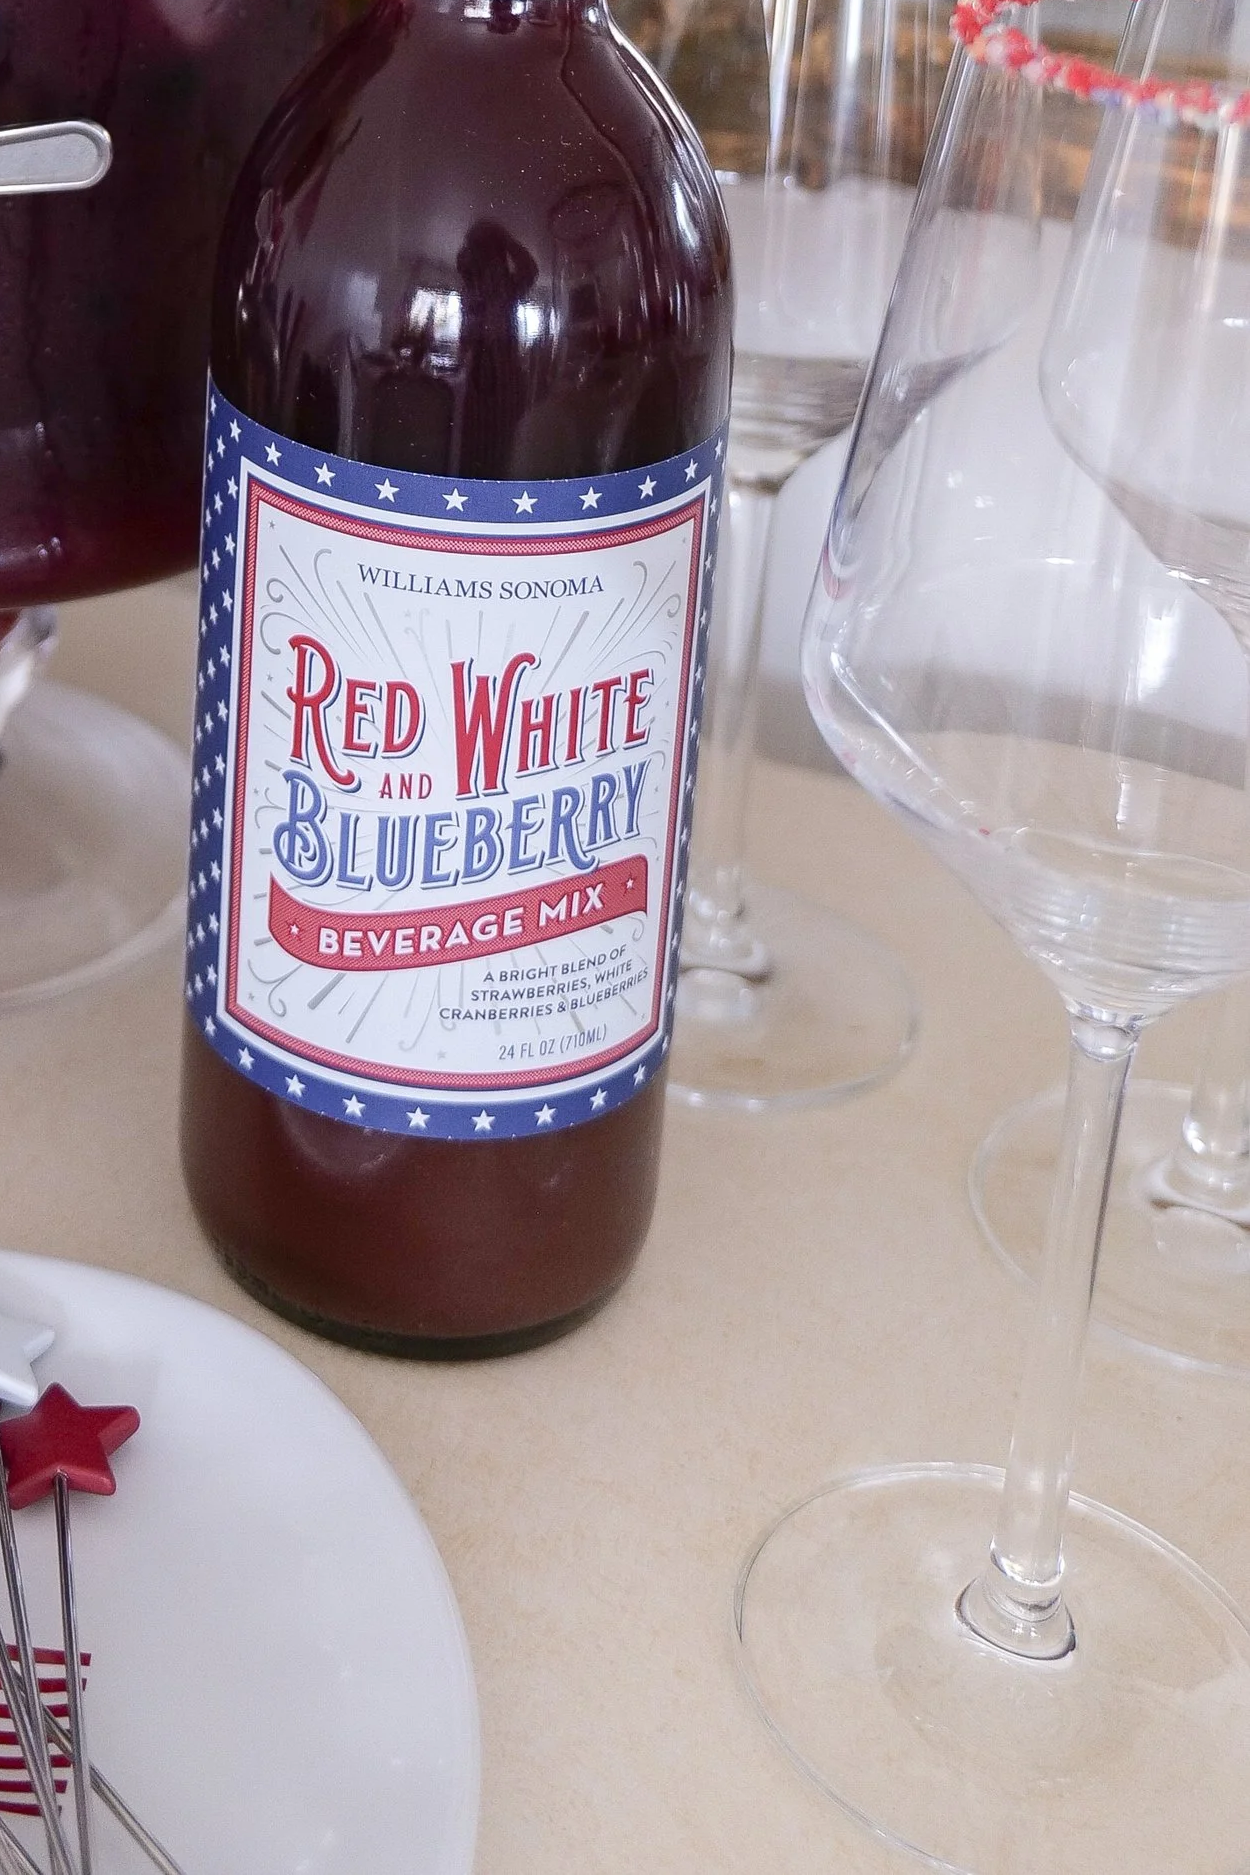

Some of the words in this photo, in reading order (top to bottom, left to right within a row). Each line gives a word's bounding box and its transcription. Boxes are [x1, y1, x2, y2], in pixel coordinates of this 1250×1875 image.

[357, 563, 493, 600] WILLIAMS
[499, 574, 605, 601] SONOMA
[286, 633, 427, 792] RED
[450, 652, 654, 800] WHITE
[380, 773, 432, 800] AND
[273, 759, 651, 892] BLUEBERRY
[318, 907, 525, 957] BEVERAGE
[538, 882, 605, 927] MIX
[471, 977, 592, 1002] STRAWBERRIES,
[594, 959, 633, 984] WHITE
[483, 971, 495, 983] A
[499, 964, 558, 982] BRIGHT
[561, 954, 606, 976] BLEND
[609, 944, 627, 961] OF
[439, 1003, 553, 1020] CRANBERRIES
[557, 1002, 567, 1013] &
[570, 966, 649, 1010] BLUEBERRIES
[498, 1044, 515, 1060] 24
[520, 1042, 535, 1058] FL
[539, 1039, 555, 1056] OZ
[559, 1023, 608, 1054] (710ML)
